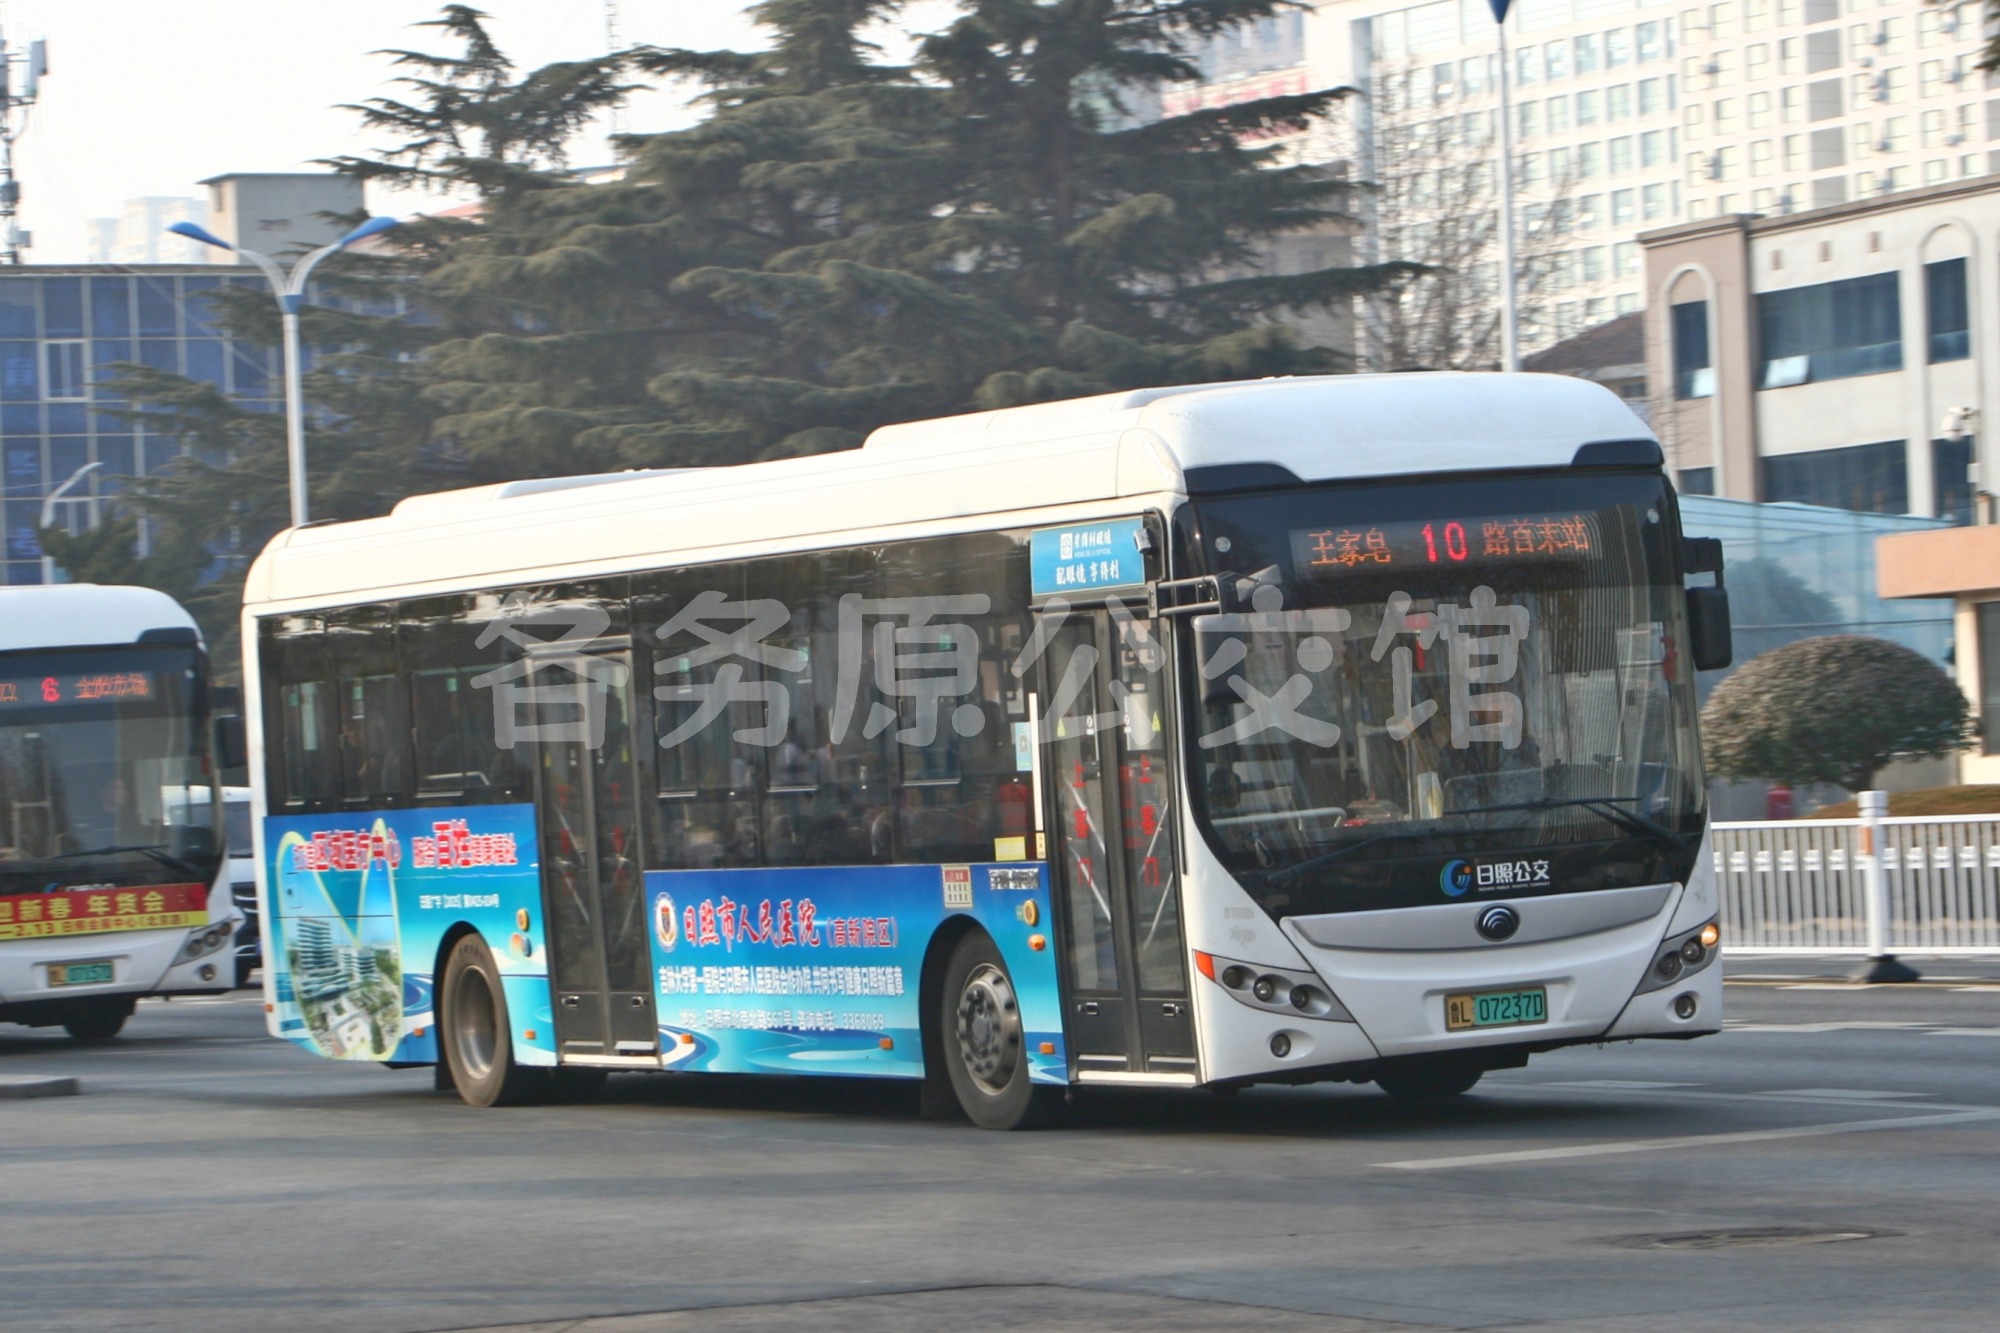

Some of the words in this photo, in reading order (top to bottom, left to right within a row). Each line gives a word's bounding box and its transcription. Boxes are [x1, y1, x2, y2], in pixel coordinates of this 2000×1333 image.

[1420, 521, 1470, 563] 10
[41, 677, 61, 702] 6
[1477, 859, 1550, 885] 日照公交
[87, 891, 165, 916] 年货会
[683, 895, 821, 953] 日照市人民医院
